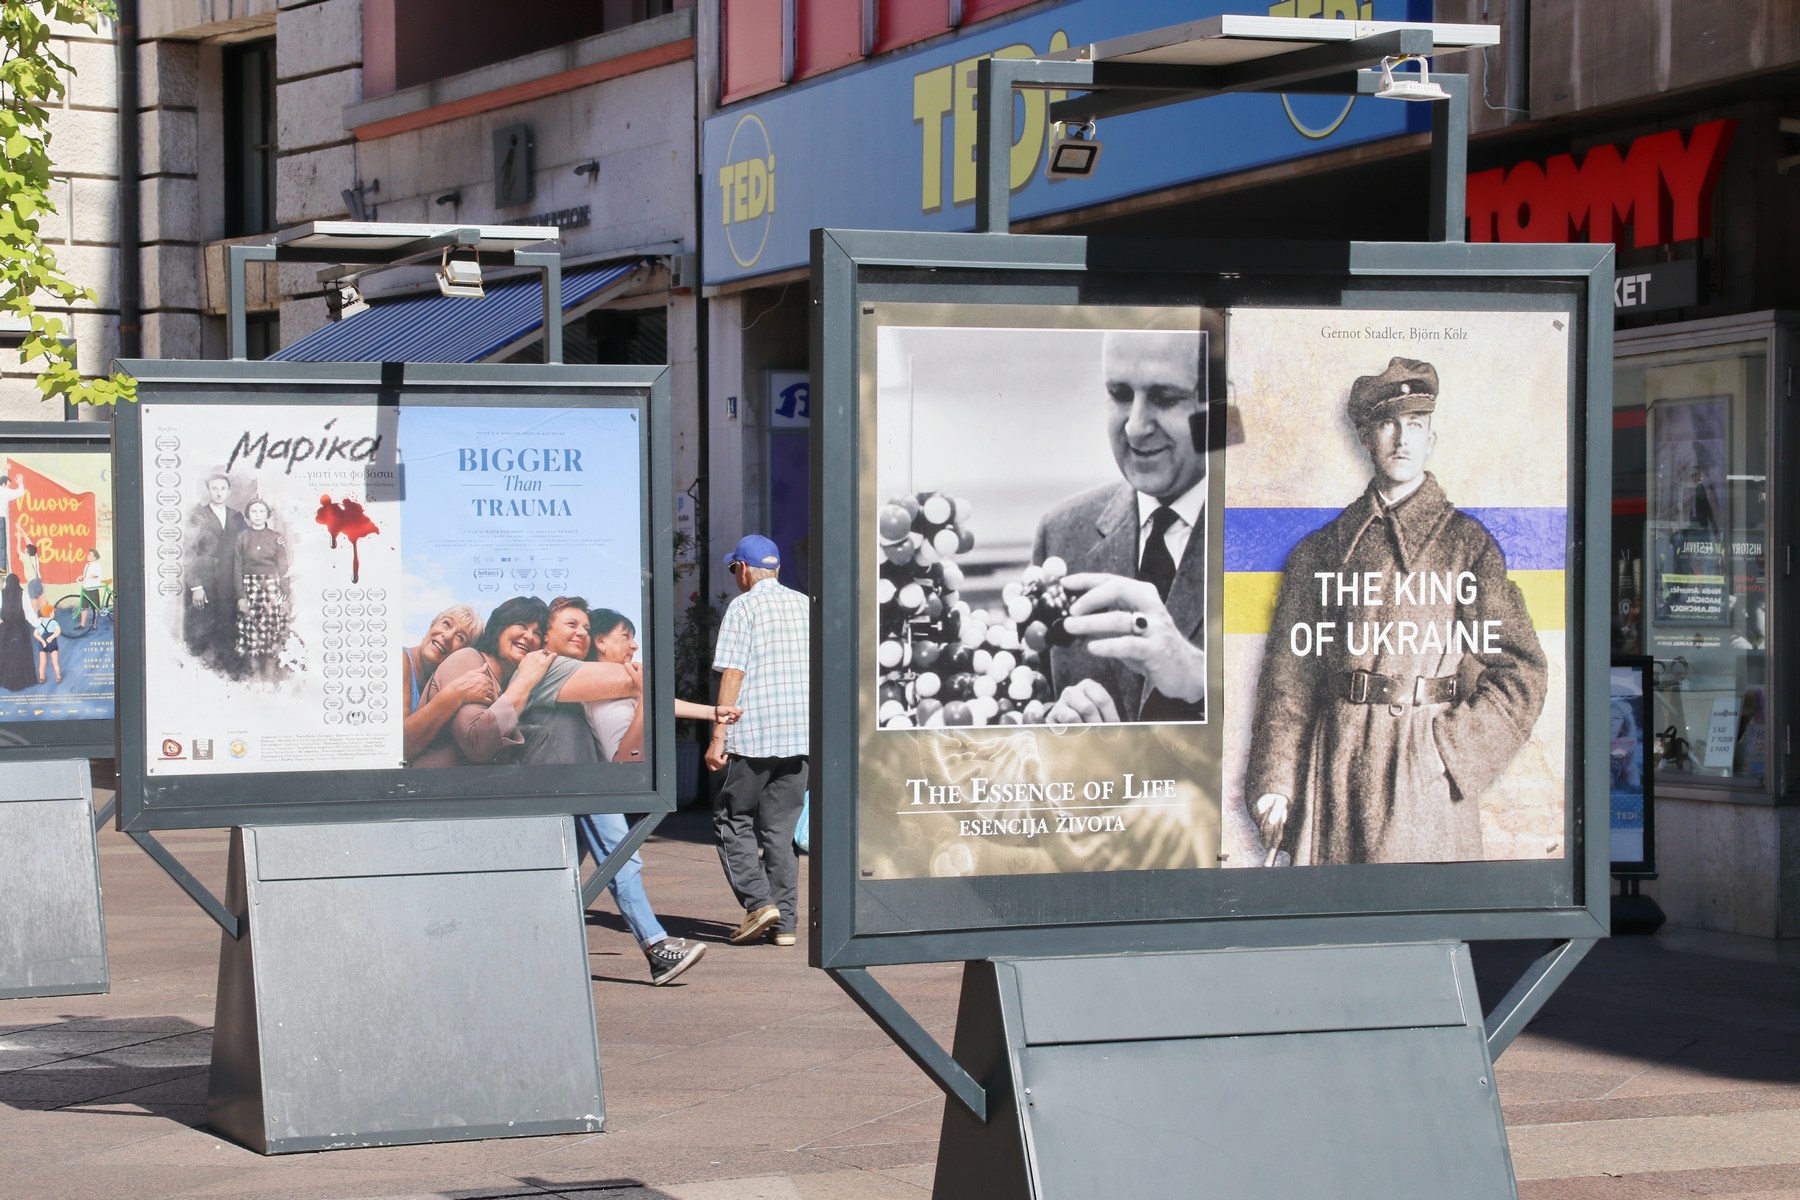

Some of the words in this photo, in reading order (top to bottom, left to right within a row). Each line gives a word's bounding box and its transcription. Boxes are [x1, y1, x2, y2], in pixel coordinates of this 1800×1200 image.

[719, 153, 775, 227] TEDi
[1465, 119, 1738, 253] TOMMY
[1321, 326, 1361, 339] Gernot
[1364, 326, 1406, 341] Stadler,
[1409, 326, 1440, 342] Björn
[1444, 326, 1468, 340] Kölz
[458, 448, 583, 472] BIGGER
[503, 475, 542, 492] Than
[16, 489, 84, 512] Nuovo
[471, 499, 572, 517] TRAUMA
[16, 512, 91, 538] Cinema
[1314, 571, 1383, 607] THE
[1395, 570, 1478, 606] KING
[1290, 621, 1336, 657] OF
[1347, 620, 1502, 656] UKRAINE
[906, 777, 962, 806] THE
[970, 776, 1075, 804] ESSENCE
[1083, 781, 1115, 801] OF
[1122, 773, 1177, 800] LIFE
[958, 817, 1049, 838] ESENCIJA
[1055, 812, 1127, 834] ŽIVOTA
[1615, 811, 1638, 820] TEDi
